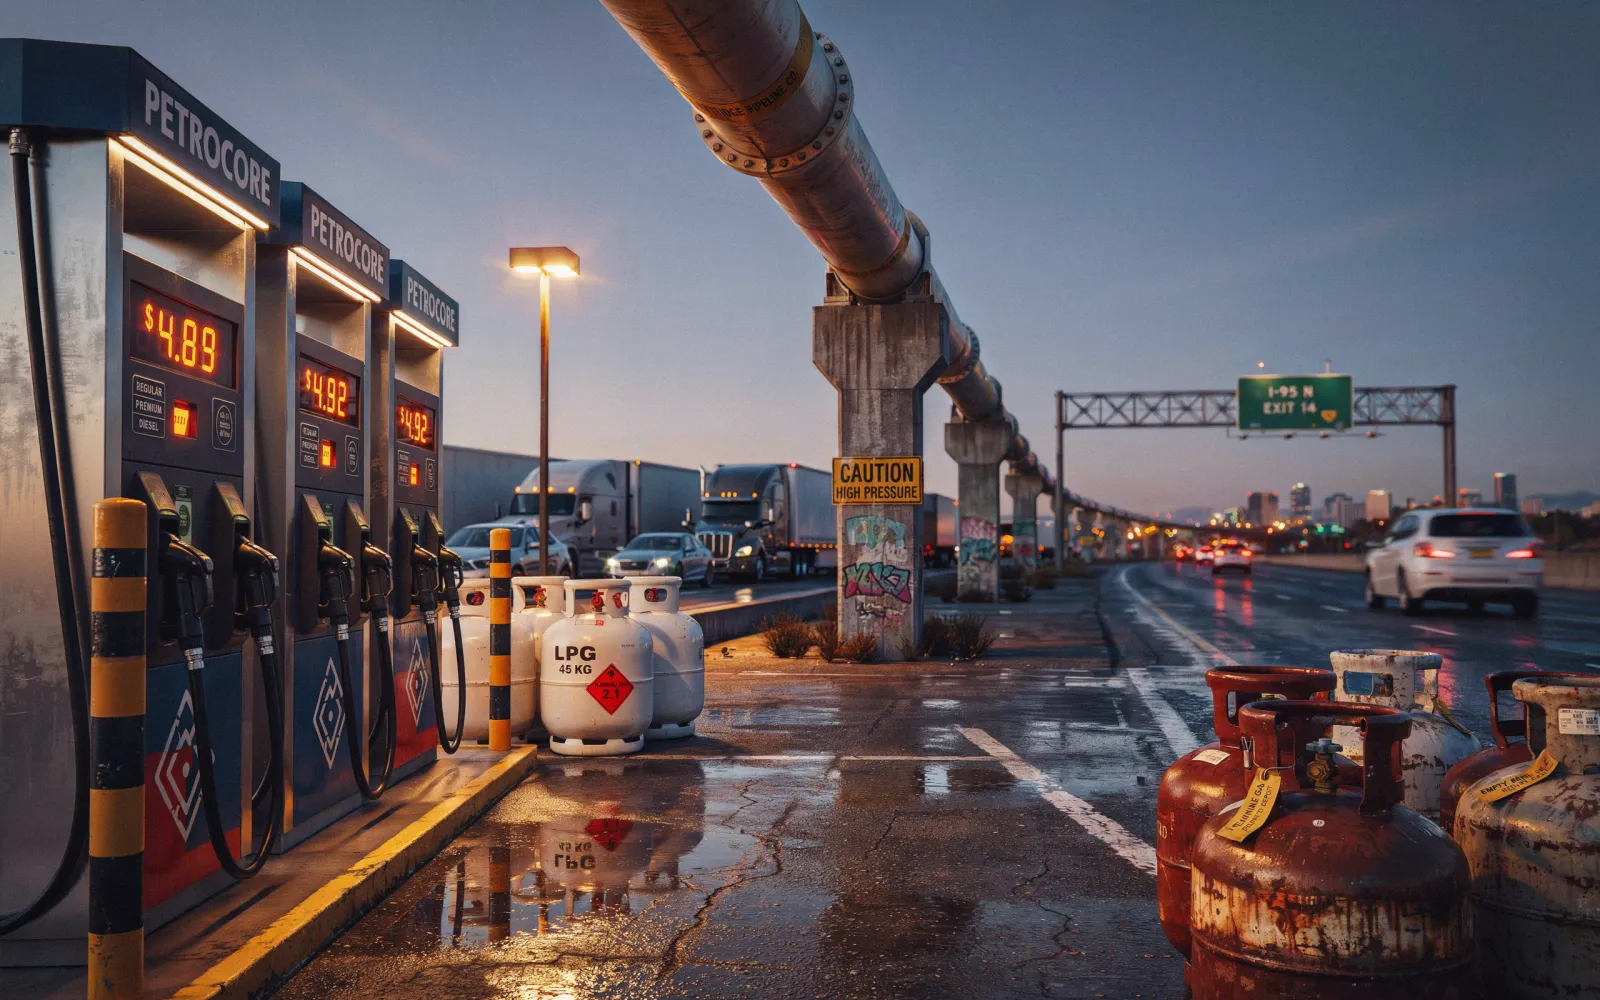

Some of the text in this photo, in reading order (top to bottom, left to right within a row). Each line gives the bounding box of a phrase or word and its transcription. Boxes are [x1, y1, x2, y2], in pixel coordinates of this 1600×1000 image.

[747, 85, 787, 113] PIPELINE
[786, 71, 799, 86] CO.
[145, 78, 271, 206] PETROCORE
[311, 203, 384, 284] PETROCORE
[407, 276, 456, 332] PETROCORE
[145, 303, 216, 373] $4.89
[136, 381, 162, 397] REGULAR
[306, 368, 347, 417] $4.92
[1268, 385, 1314, 398] I-95 N
[135, 400, 162, 414] PREMIUM
[1263, 402, 1295, 415] EXIT
[139, 419, 159, 431] DIESEL
[400, 406, 427, 443] $4.92
[840, 462, 914, 483] CAUTION
[836, 486, 917, 499] HIGH PRESSURE
[554, 645, 597, 661] LPG
[559, 664, 592, 674] 45 KG
[602, 689, 619, 699] 2.1
[1480, 780, 1509, 795] EMPTY
